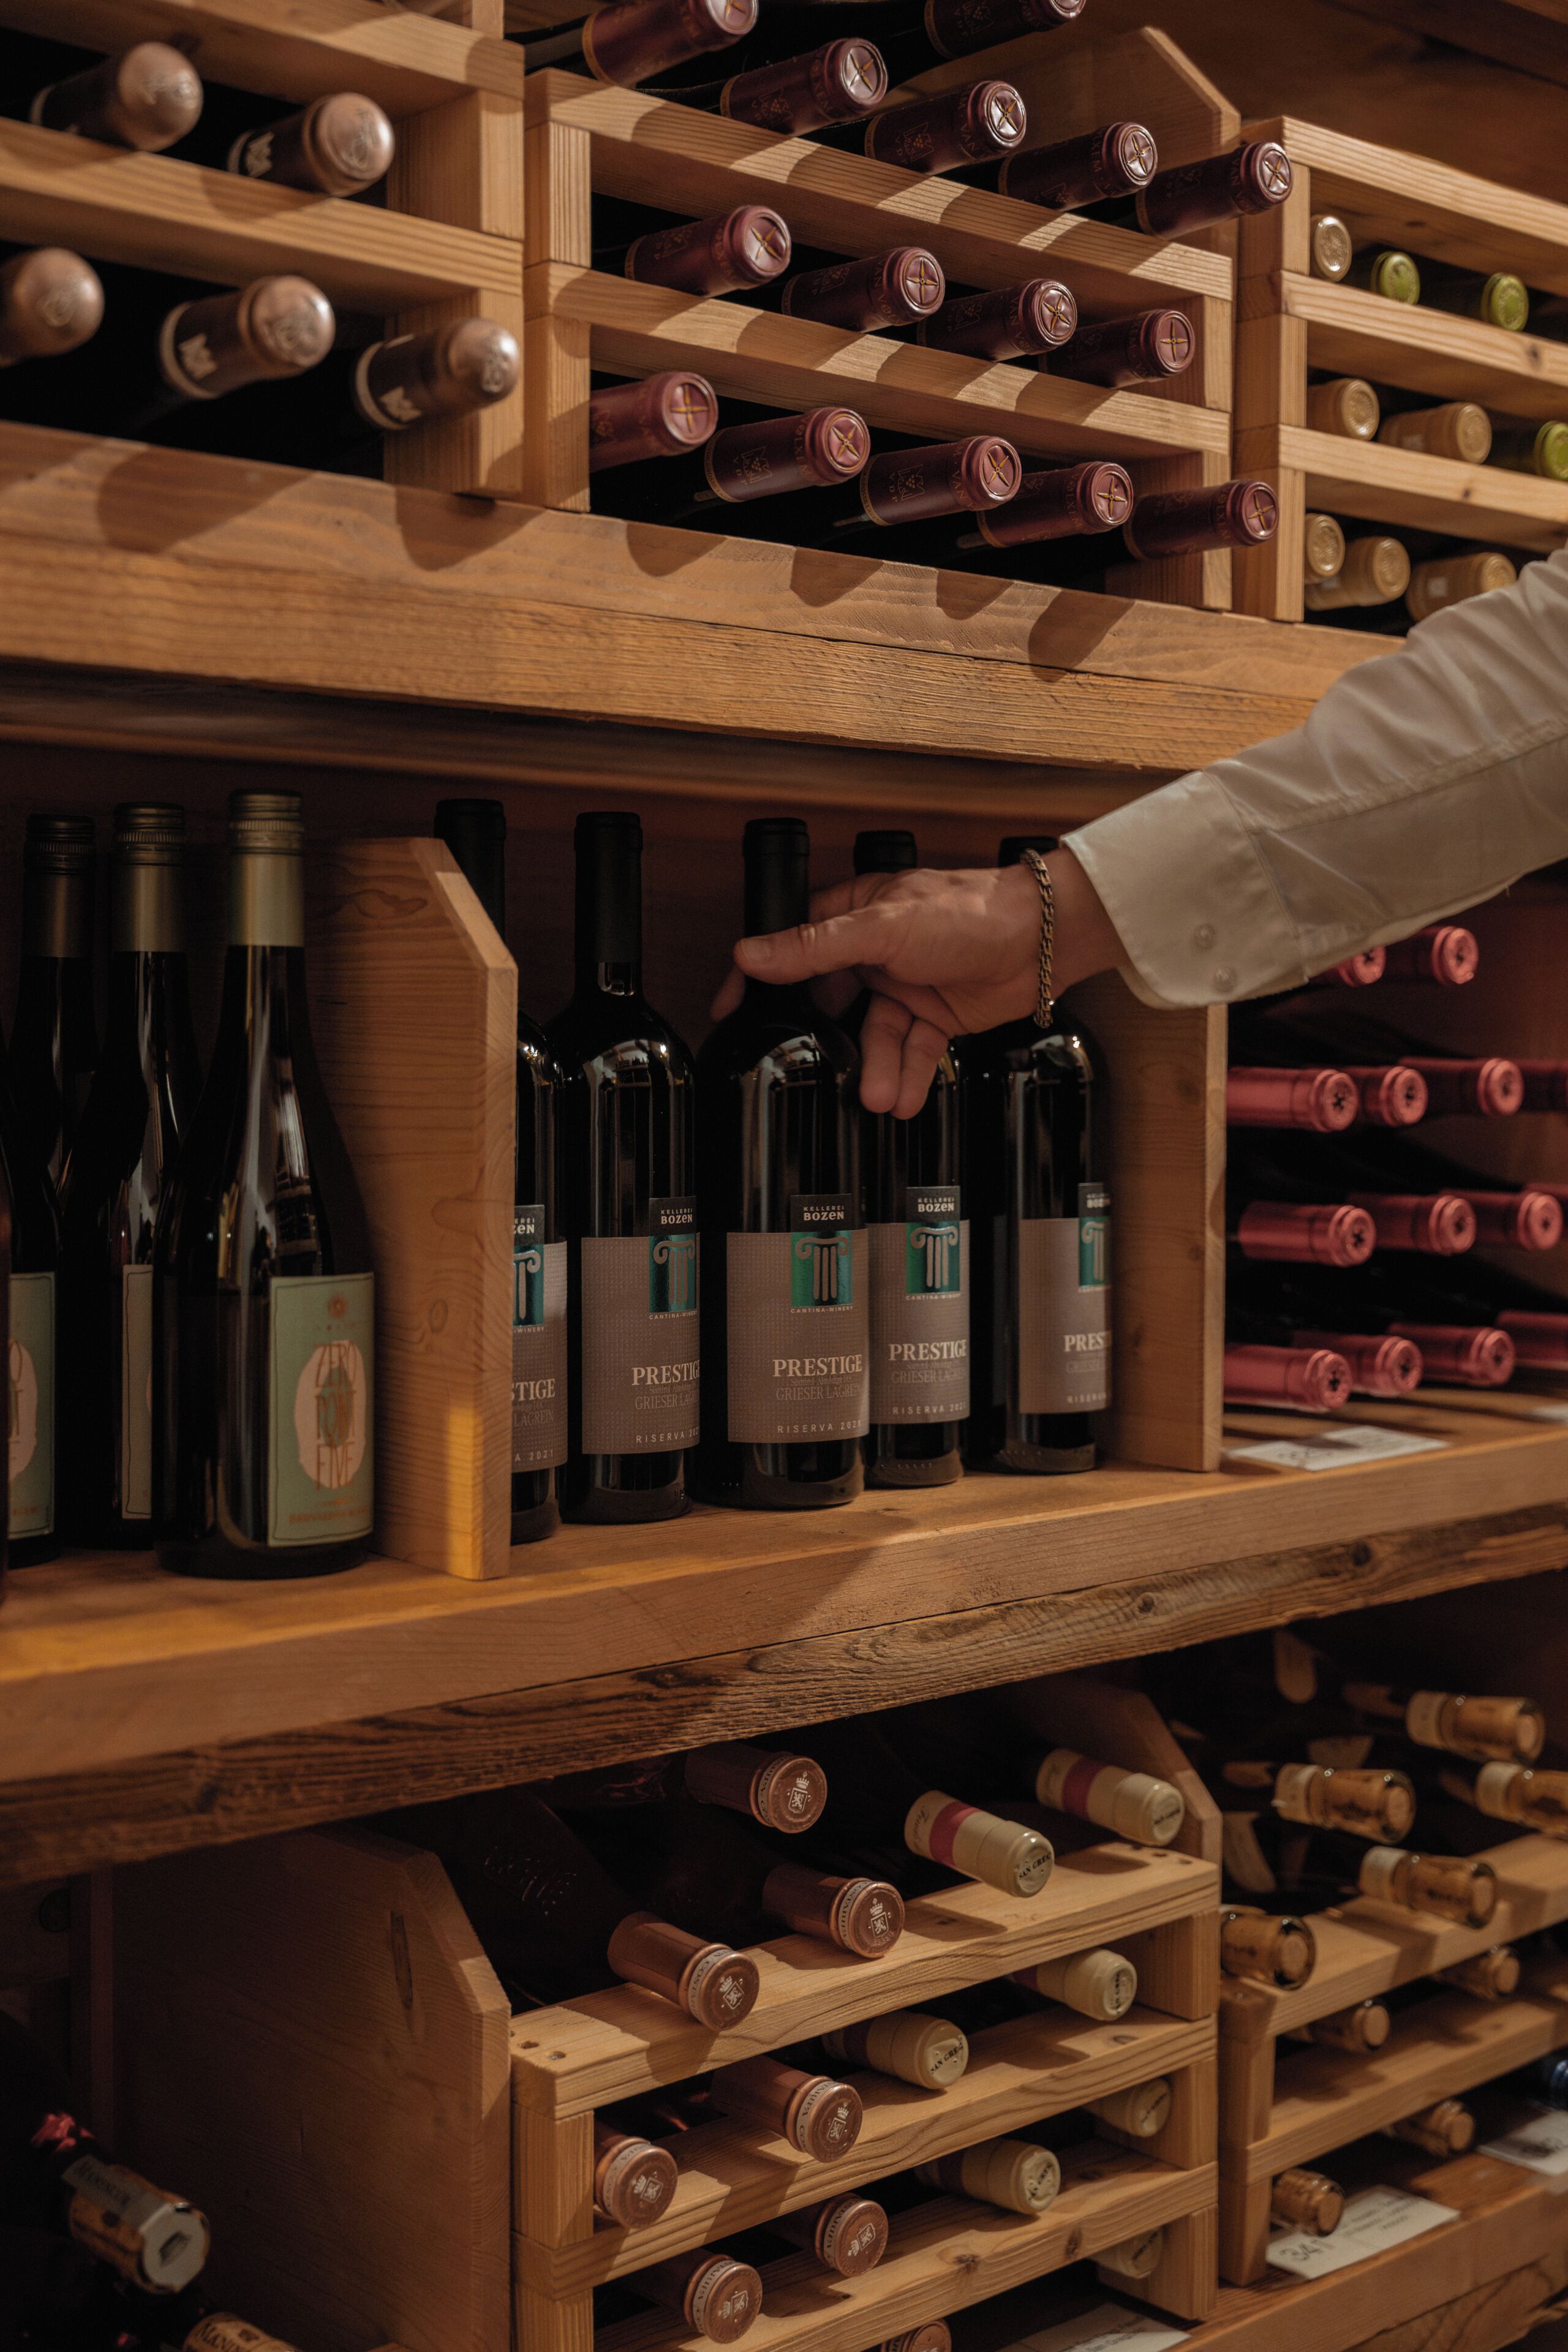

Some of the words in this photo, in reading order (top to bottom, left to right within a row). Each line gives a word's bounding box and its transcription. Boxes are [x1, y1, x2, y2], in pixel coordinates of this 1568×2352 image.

[952, 470, 968, 500] VAN
[888, 1339, 967, 1362] PRESTIGE
[315, 1340, 356, 1388] ZERO
[772, 1354, 862, 1378] PRESTIGE
[635, 1393, 679, 1411] GRIESER
[775, 1386, 824, 1401] GRIESER
[892, 1404, 945, 1415] RISERVA
[636, 1431, 685, 1444] RISERVA
[777, 1423, 834, 1434] RISERVA
[530, 1449, 554, 1461] 2021
[315, 1441, 355, 1491] FIVE
